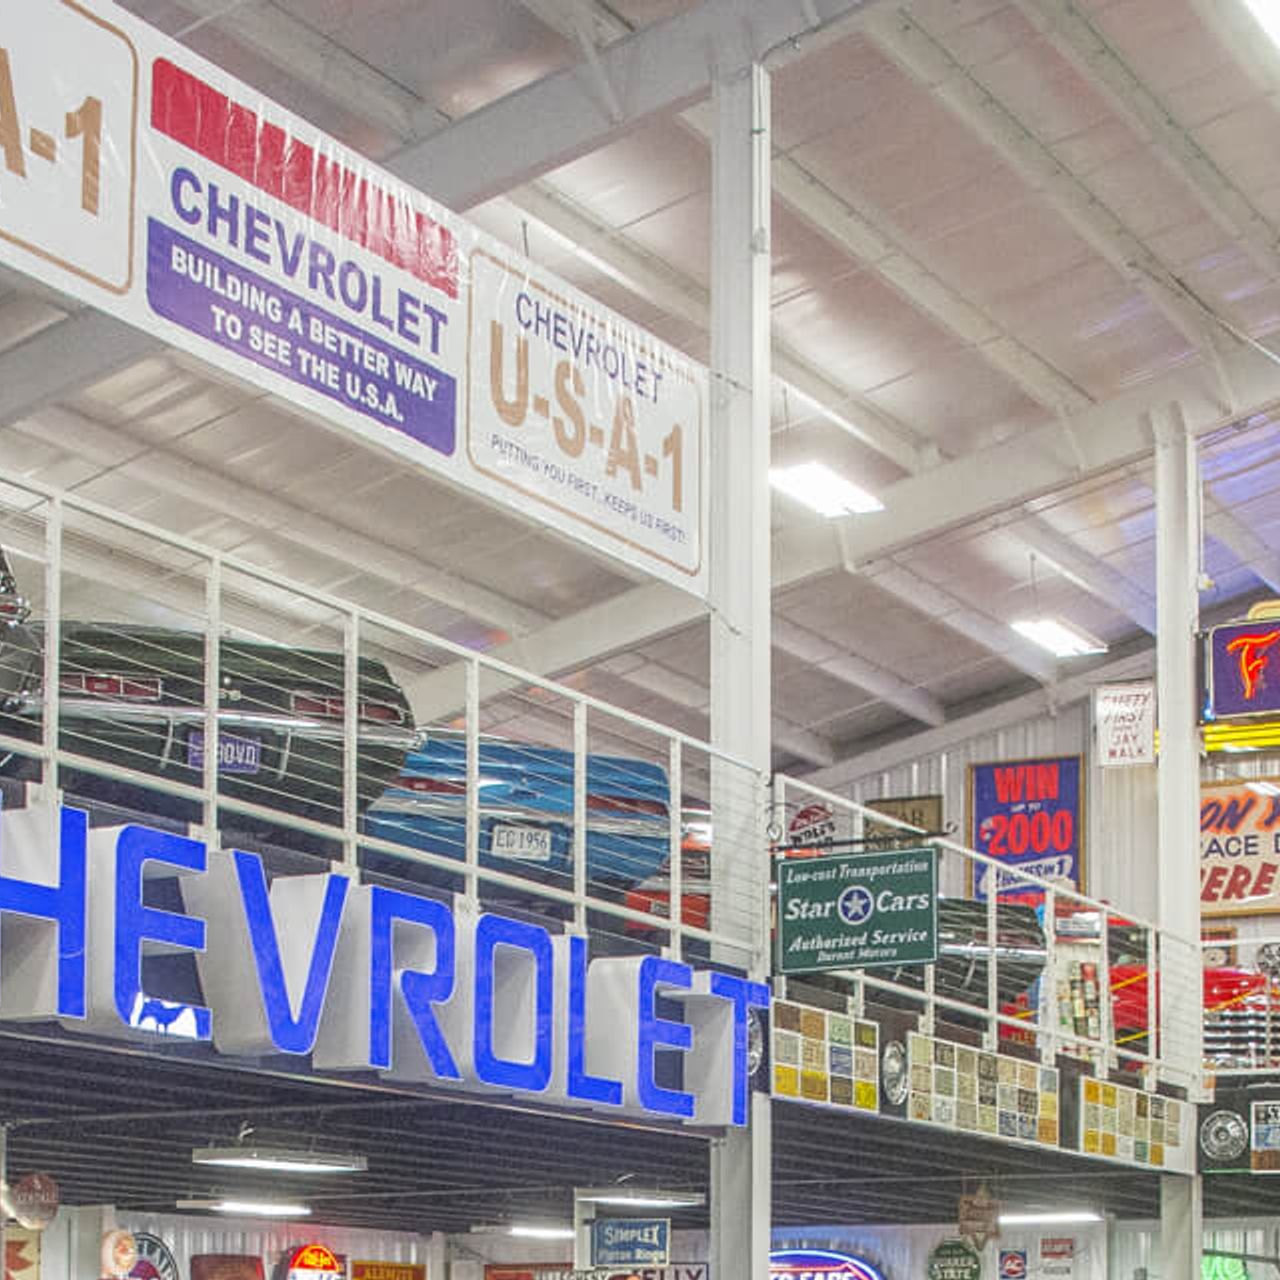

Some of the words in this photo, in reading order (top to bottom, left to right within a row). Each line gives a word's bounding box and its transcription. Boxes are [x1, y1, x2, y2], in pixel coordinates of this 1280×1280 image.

[170, 167, 448, 355] CHEVROLET
[171, 245, 282, 324] BUILDING
[288, 307, 304, 334] A
[310, 313, 388, 382] BETTER
[394, 360, 438, 403] WAY
[210, 305, 242, 341] TO
[249, 324, 291, 367] SEE
[297, 352, 340, 394] THE
[345, 374, 404, 424] U.S.A.
[516, 291, 663, 405] CHEVROLET
[489, 319, 684, 514] U-S-A-1
[490, 433, 540, 474] PUTTING
[543, 457, 566, 487] YOU
[604, 492, 638, 520] KEEPS
[639, 508, 655, 529] US
[993, 762, 1060, 804] WIN
[1201, 792, 1255, 833] ON
[1201, 834, 1258, 859] ACE
[839, 860, 929, 882] Transportation
[1201, 863, 1277, 902] ERE
[784, 898, 835, 921] Star
[876, 890, 930, 913] Cars
[788, 932, 868, 952] Authorized
[872, 927, 928, 945] Service
[604, 1225, 660, 1246] SIMPLEX
[934, 1267, 972, 1280] STATE
